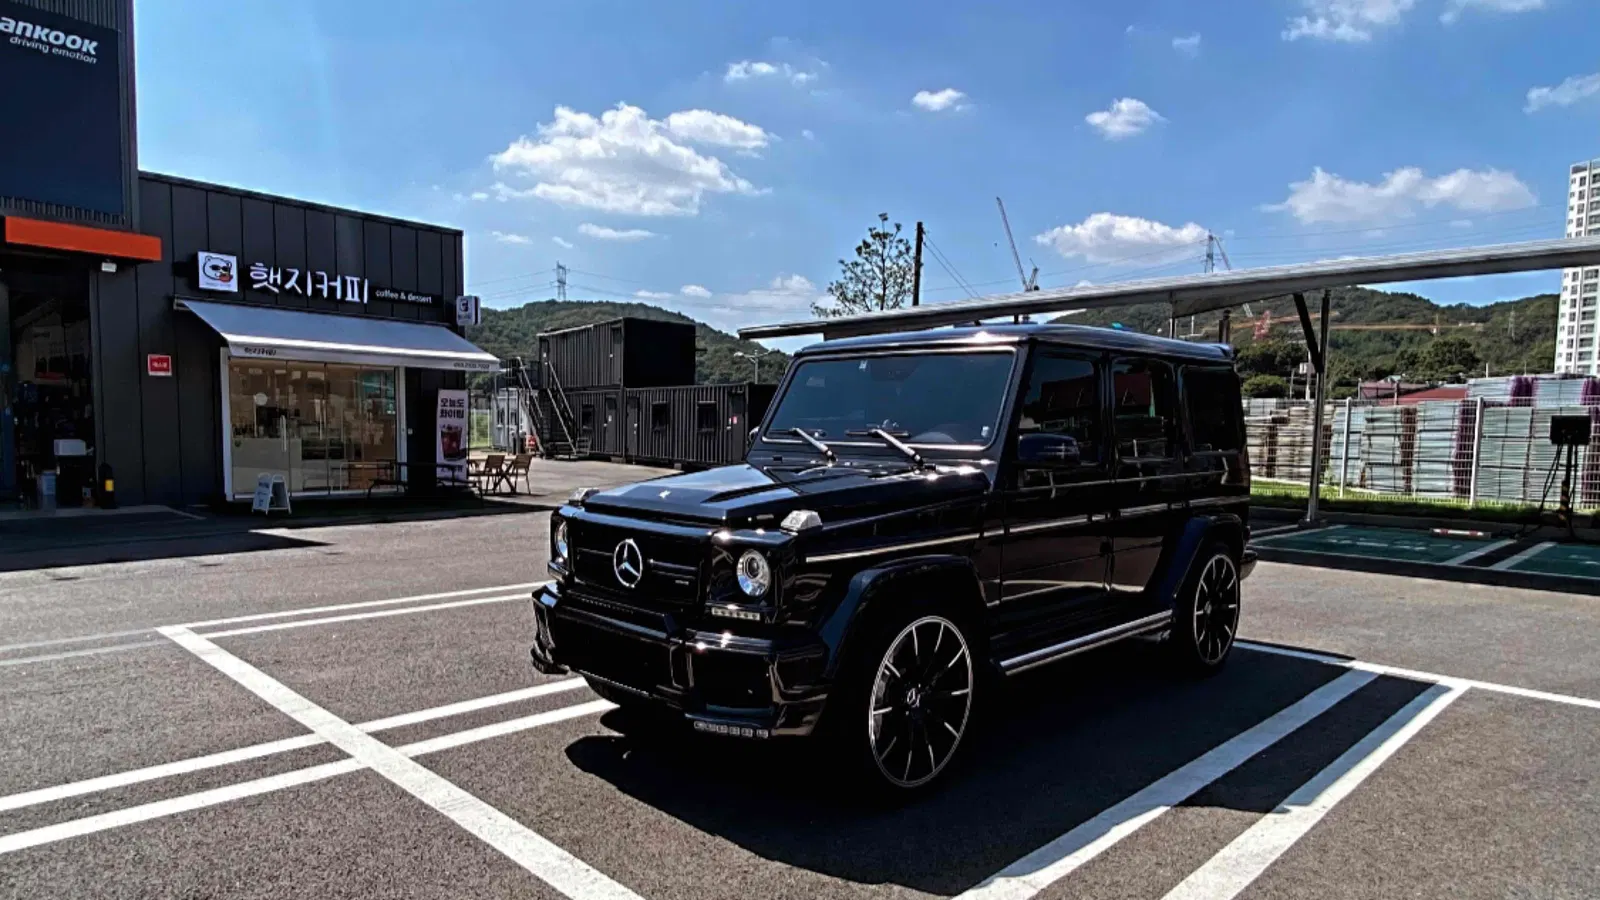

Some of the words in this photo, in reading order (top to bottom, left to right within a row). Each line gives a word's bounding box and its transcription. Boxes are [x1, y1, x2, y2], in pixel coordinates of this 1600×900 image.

[9, 36, 49, 53] driving
[52, 47, 97, 64] emotion
[250, 262, 368, 304] 햇지커피
[374, 289, 399, 300] coffee
[407, 293, 432, 303] dessert
[440, 397, 465, 408] 오늘도
